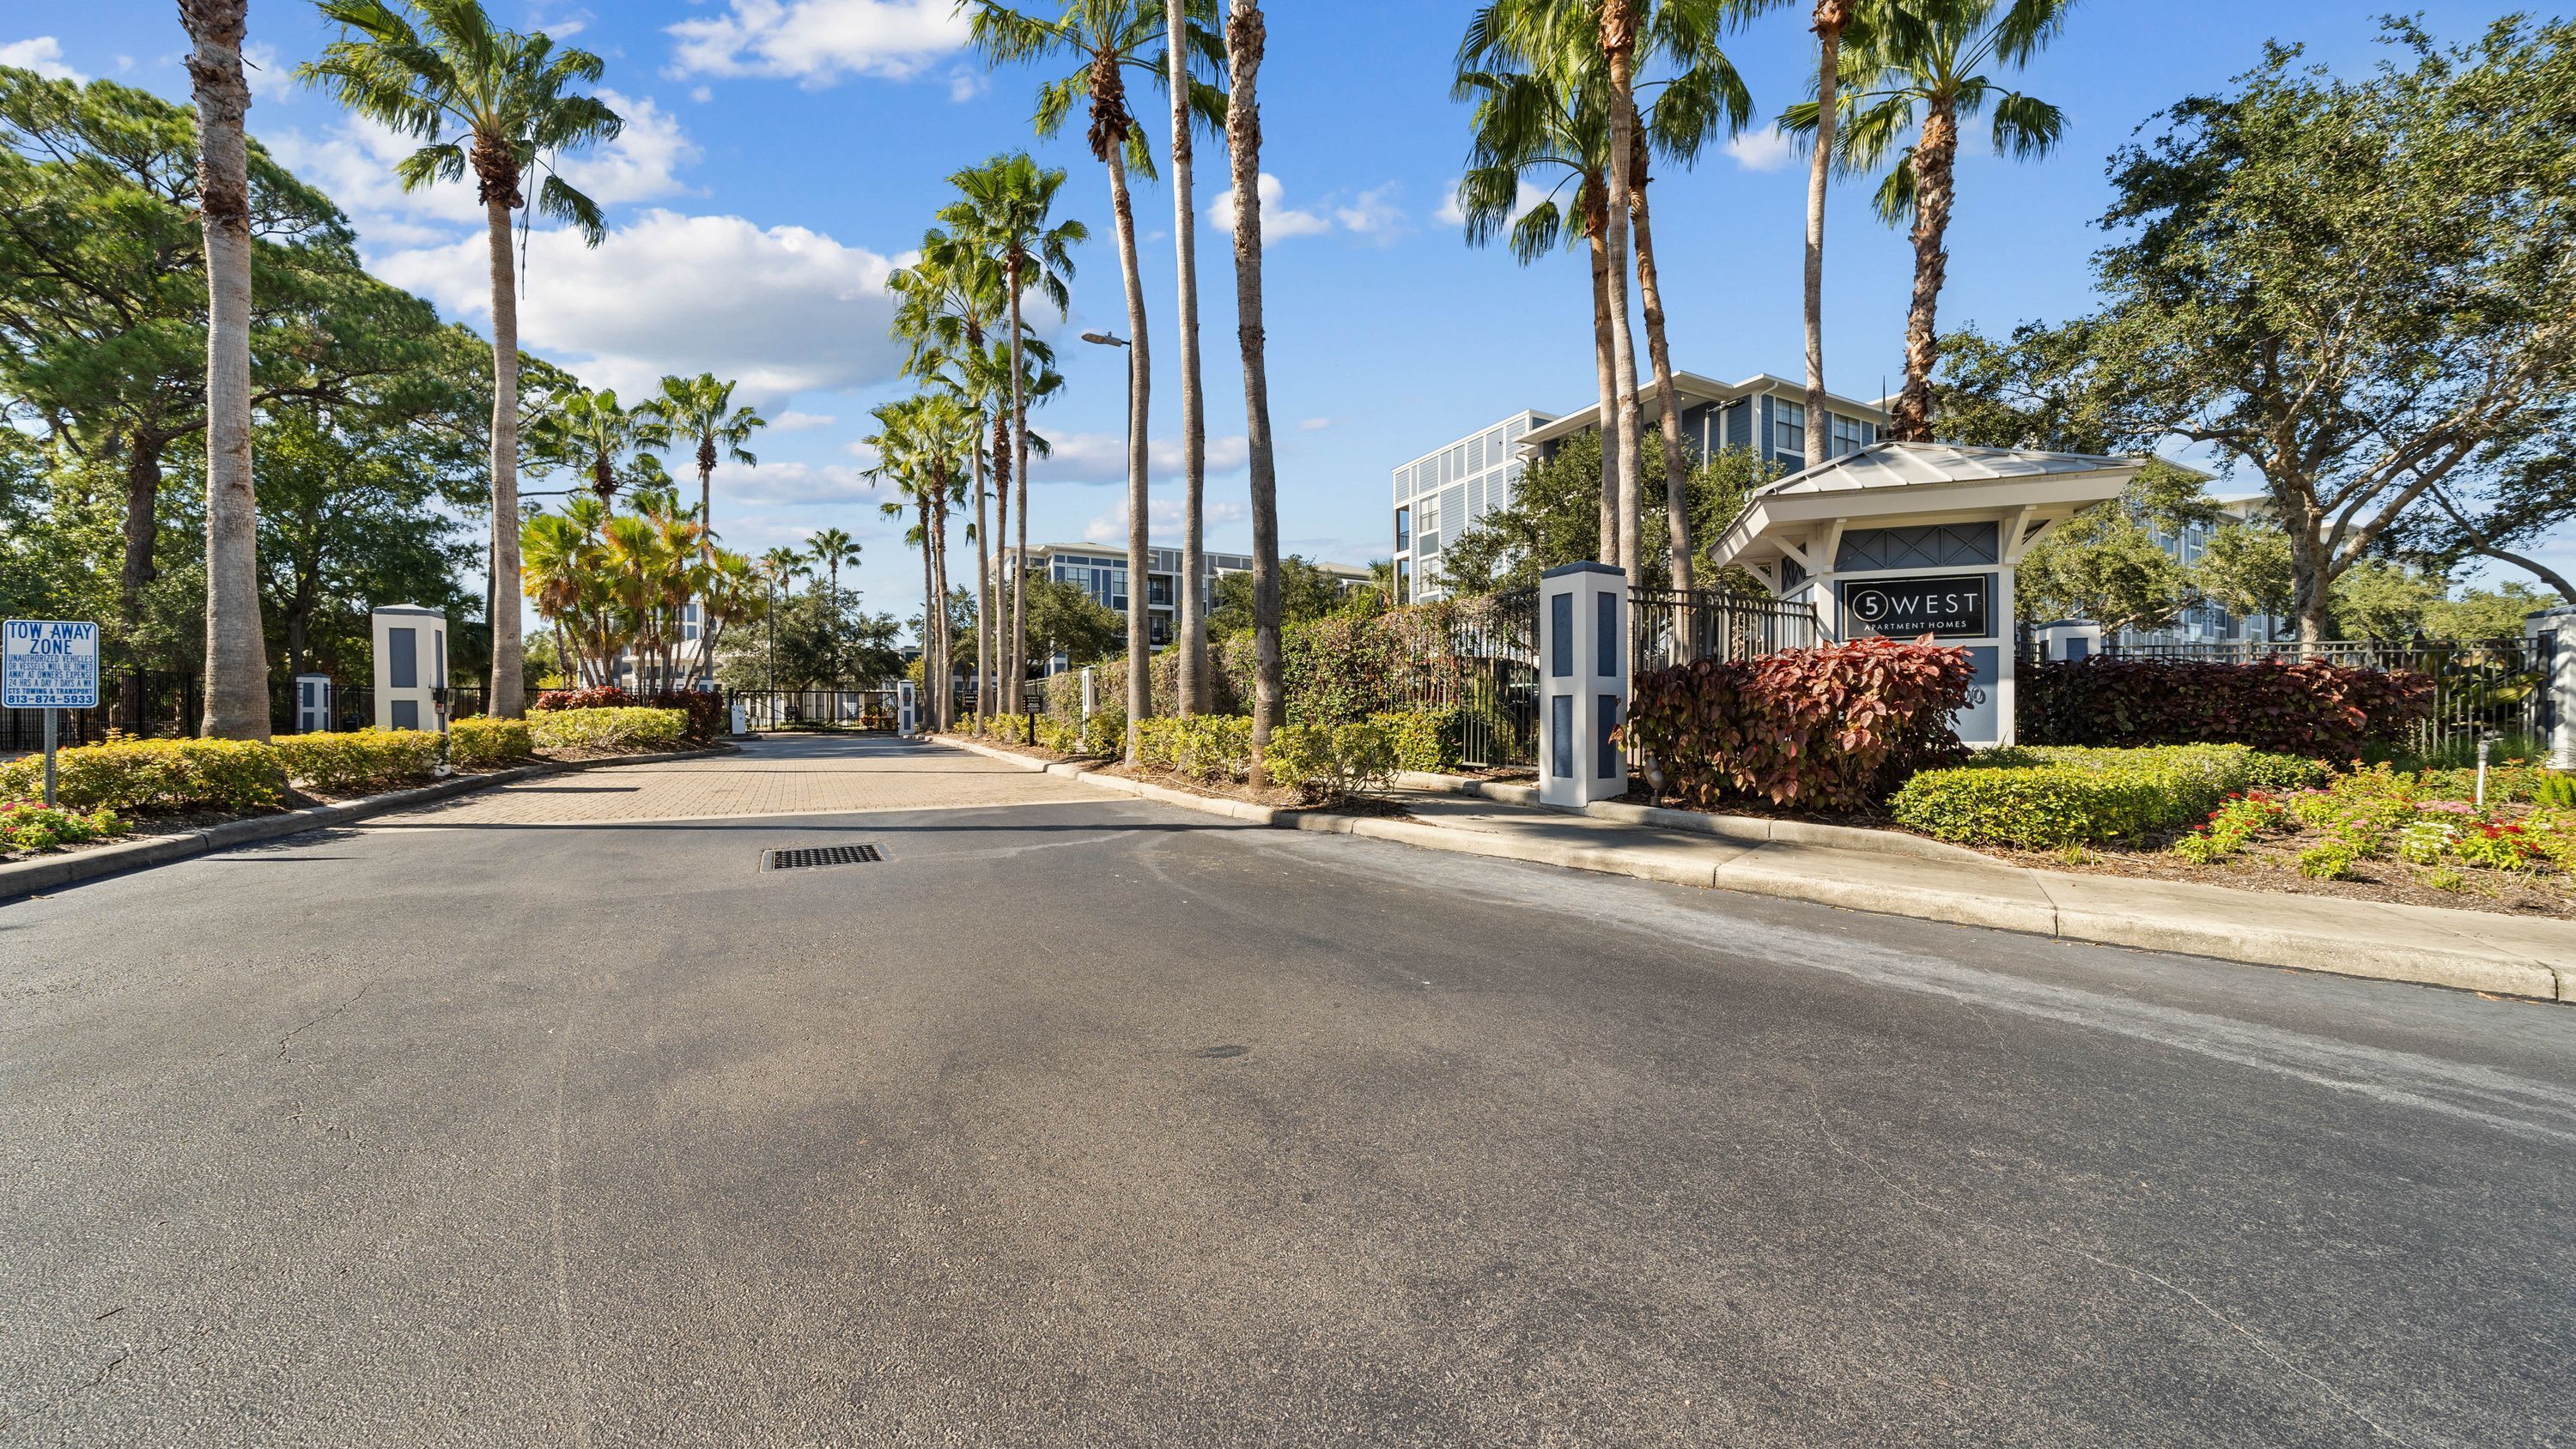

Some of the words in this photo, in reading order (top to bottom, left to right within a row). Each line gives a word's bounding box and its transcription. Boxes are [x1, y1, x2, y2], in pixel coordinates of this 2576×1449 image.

[1891, 593, 1978, 615] WEST
[9, 623, 42, 639] TOW
[51, 624, 92, 639] AWAY
[1864, 621, 1924, 631] APARTMENT
[1929, 620, 1967, 628] HOMES
[30, 639, 72, 654] ZONE
